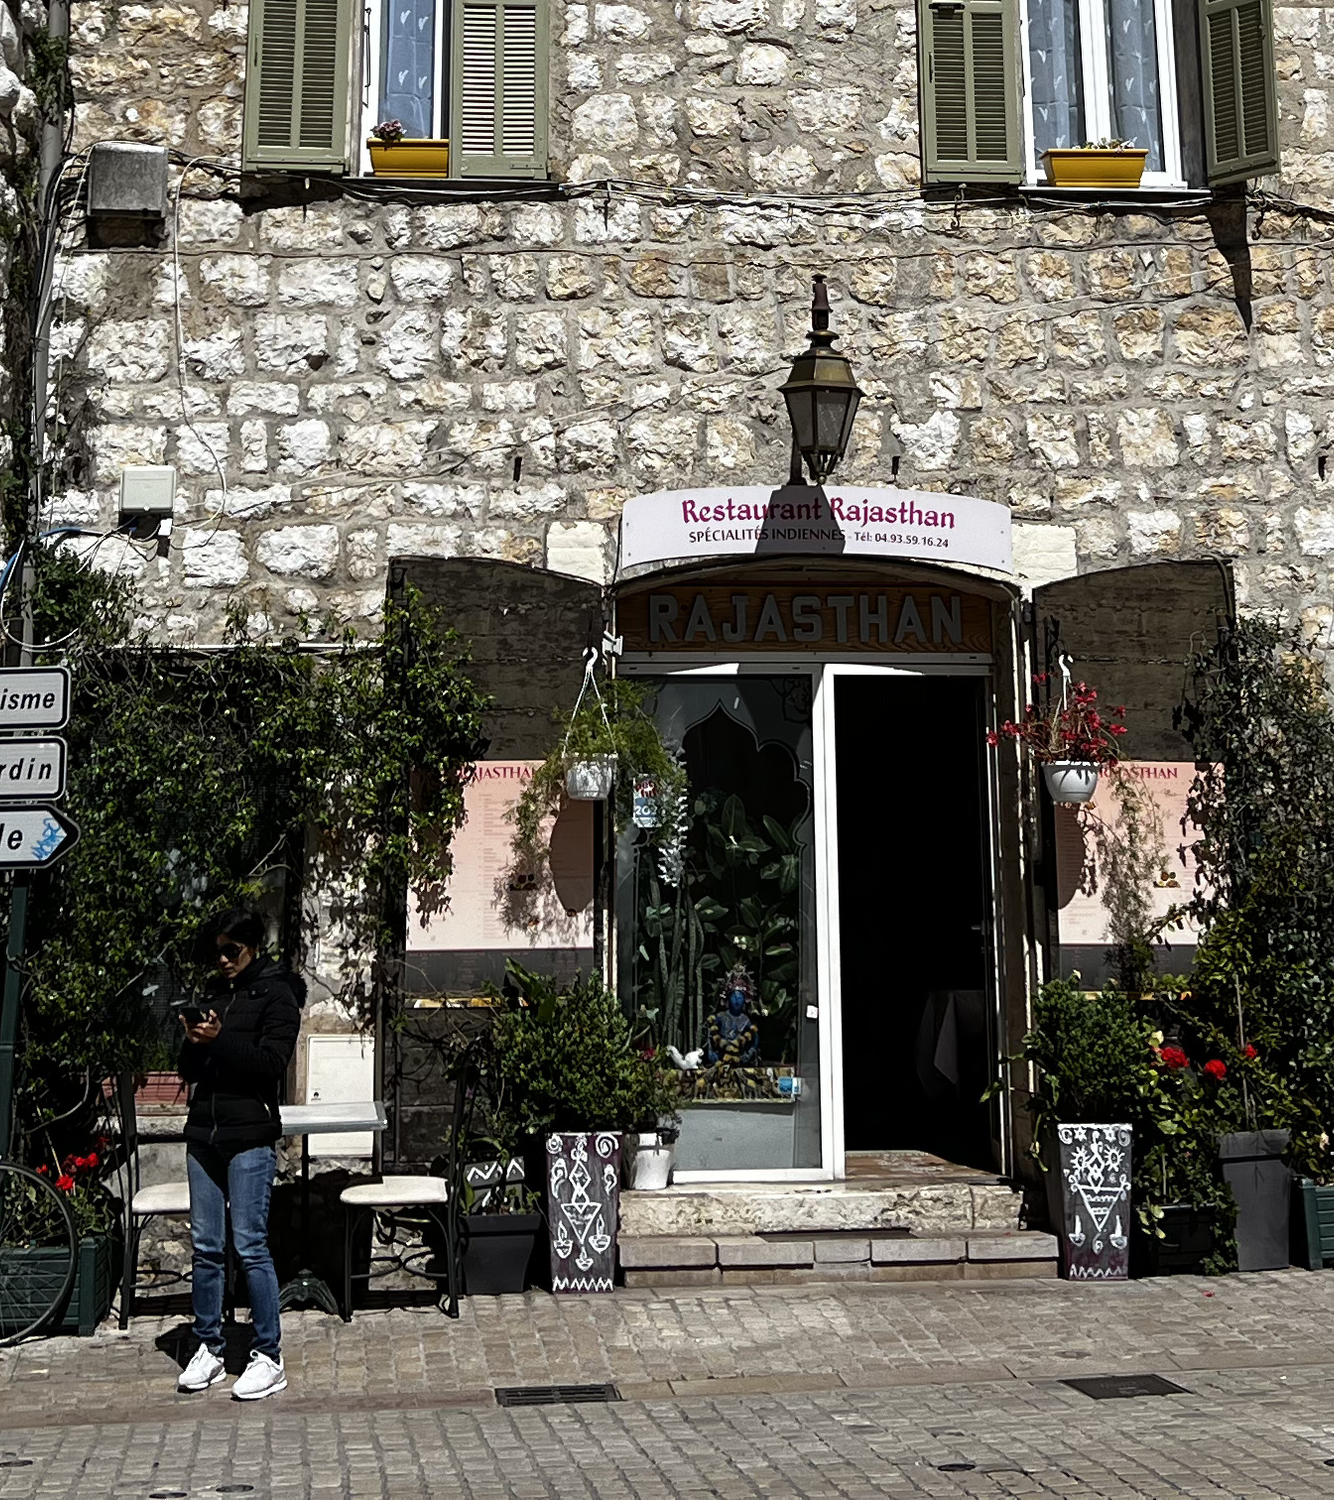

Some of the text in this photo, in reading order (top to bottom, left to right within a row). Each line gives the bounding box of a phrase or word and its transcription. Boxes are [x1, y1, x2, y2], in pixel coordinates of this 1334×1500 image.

[681, 497, 955, 529] Restaurant Rajasthan
[688, 525, 769, 543] SPÉCIALITÉS
[771, 528, 846, 541] INDIENNES
[874, 533, 949, 548] 04.93.59.16.24
[648, 594, 963, 644] RAJASTHAN
